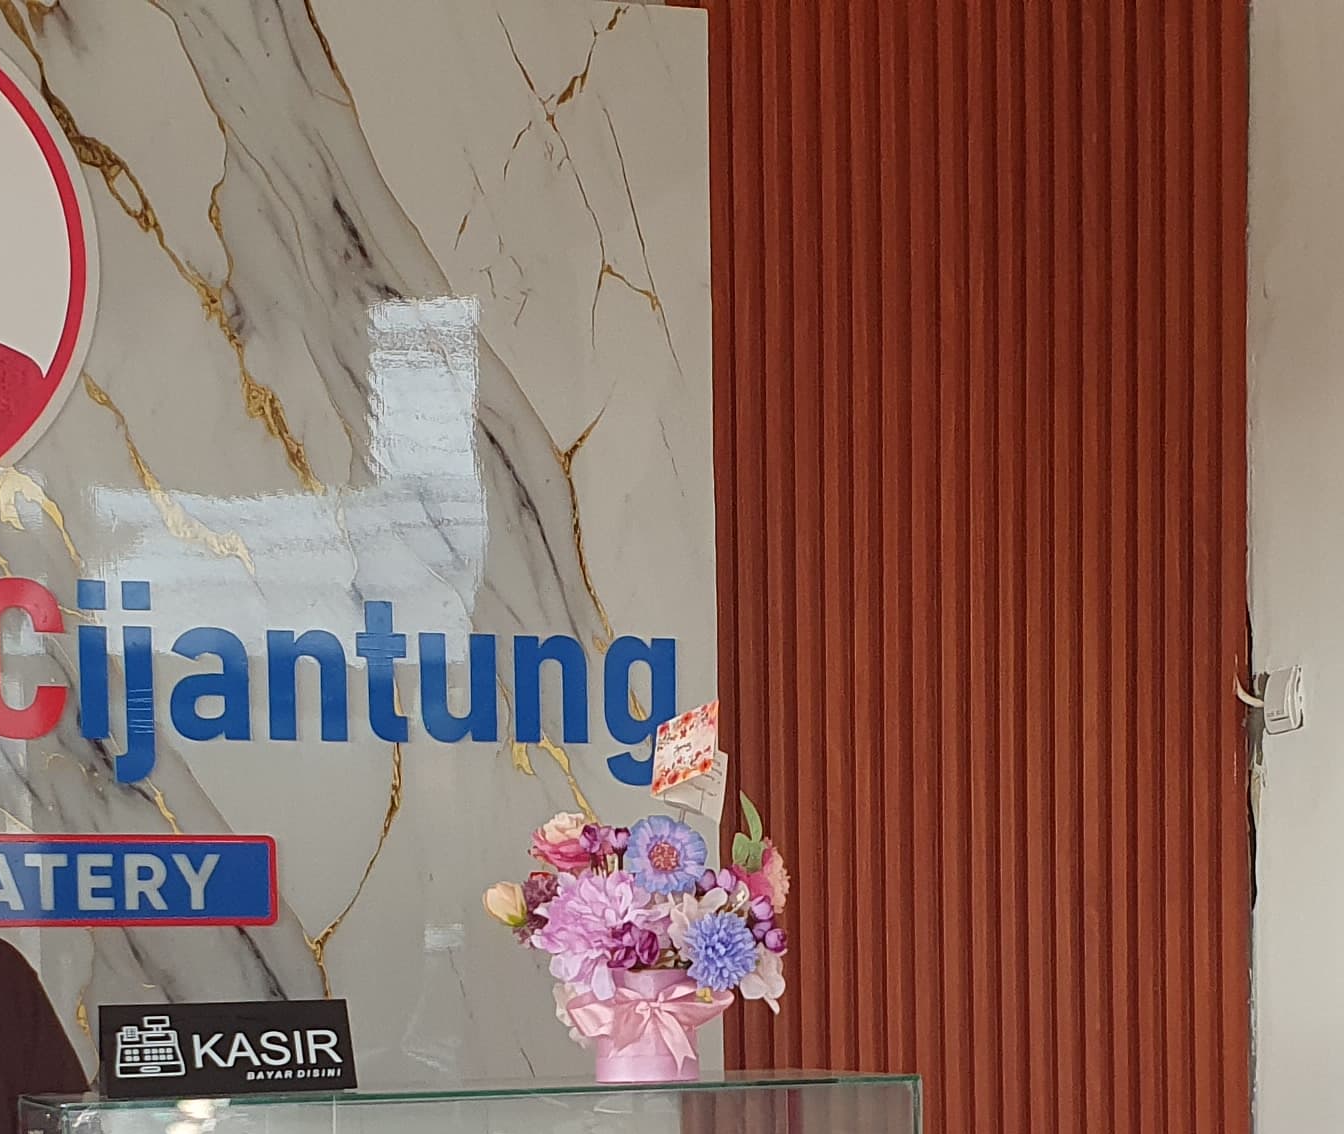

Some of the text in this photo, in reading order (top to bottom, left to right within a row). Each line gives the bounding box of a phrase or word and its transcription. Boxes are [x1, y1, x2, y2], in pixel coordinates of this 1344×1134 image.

[192, 1029, 343, 1069] KASIR
[246, 1067, 342, 1081] BAYAR DISINI
